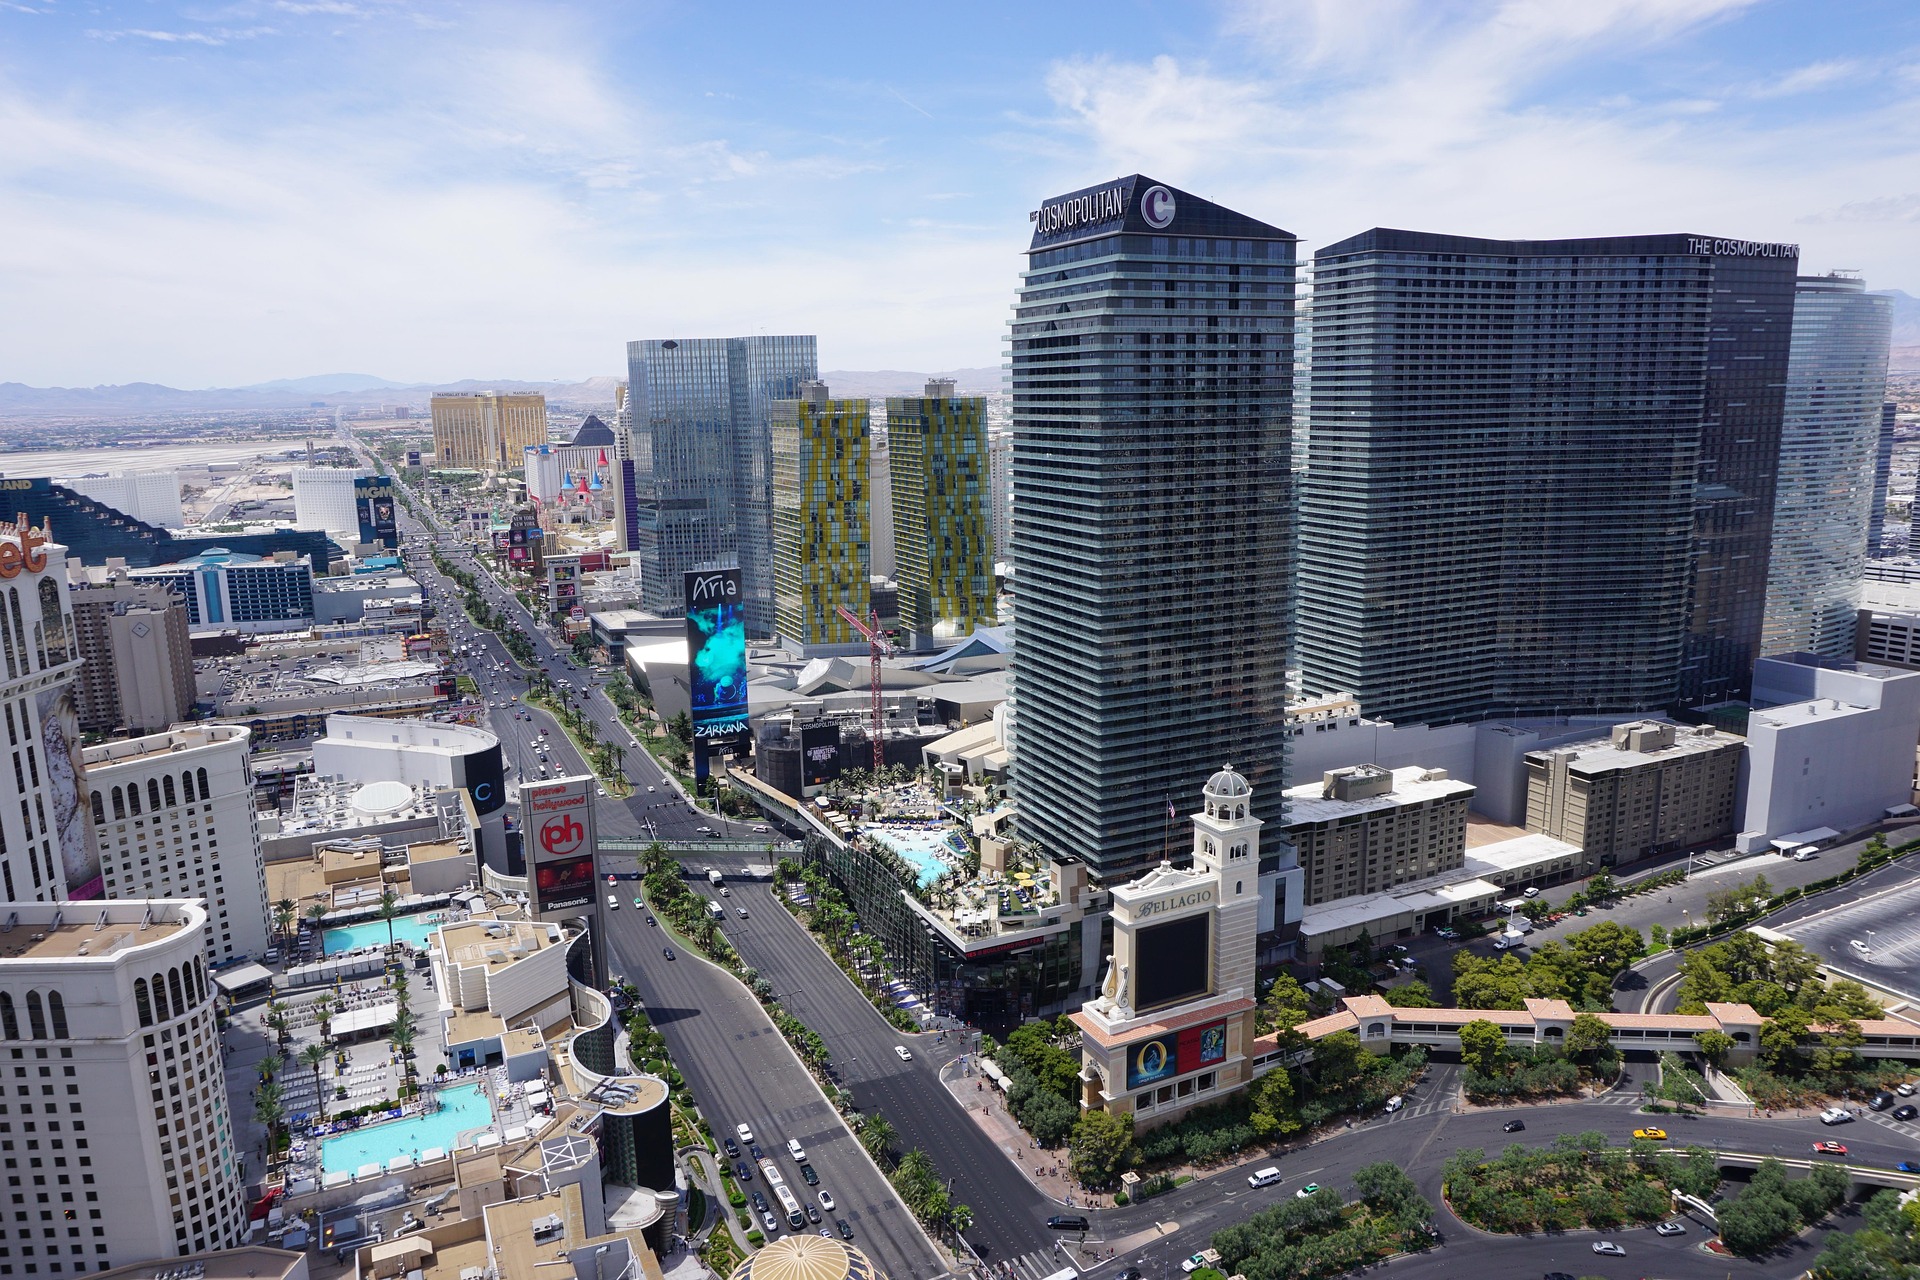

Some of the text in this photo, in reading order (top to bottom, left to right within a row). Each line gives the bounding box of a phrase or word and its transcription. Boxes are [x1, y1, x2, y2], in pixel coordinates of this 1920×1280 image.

[1037, 187, 1122, 233] COSMOPOLITAN
[1688, 238, 1800, 258] THE COSMOPOLITAN
[355, 486, 393, 499] MGM
[693, 574, 737, 601] Aria
[695, 721, 748, 737] ZARKANA
[803, 718, 840, 730] COSMOPOLITAN
[719, 747, 734, 756] Aria
[531, 786, 567, 799] planet
[532, 795, 585, 811] hollywood
[544, 814, 584, 853] ph
[547, 897, 588, 910] Panasonic
[1134, 890, 1212, 919] BELLAGIO
